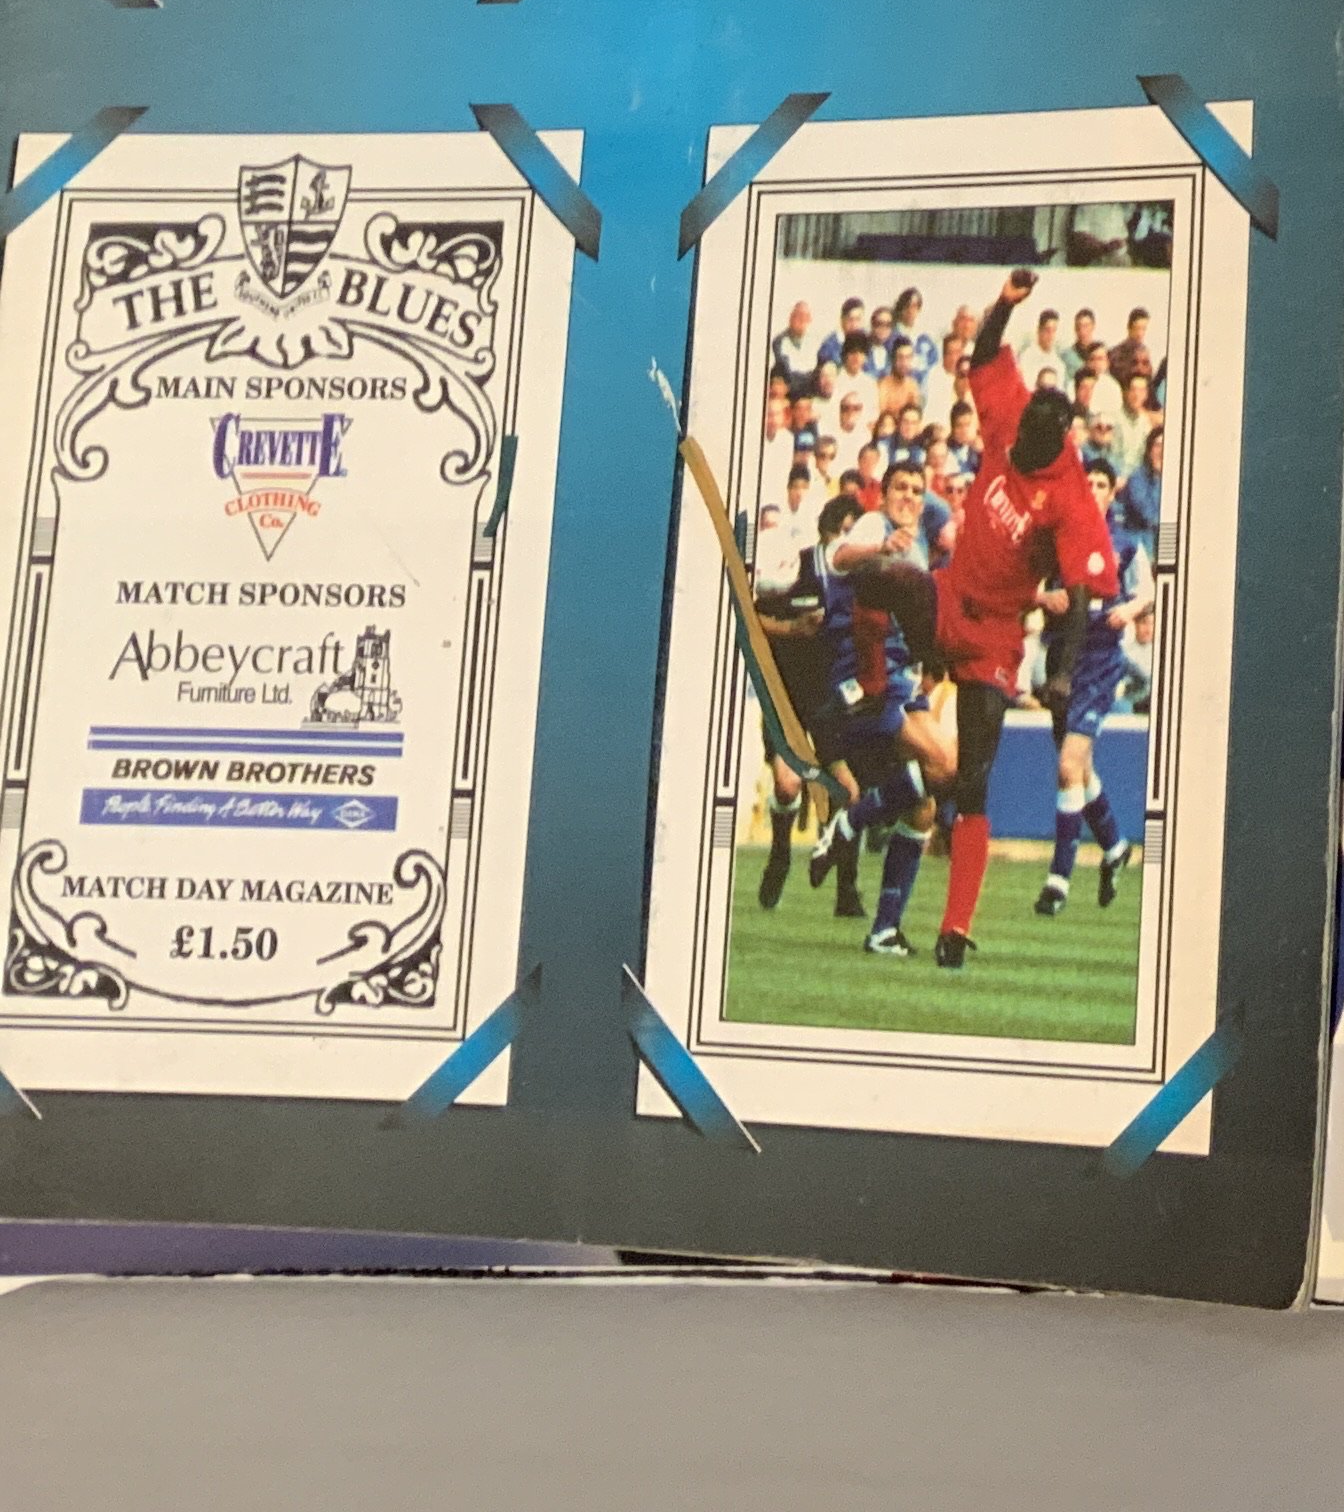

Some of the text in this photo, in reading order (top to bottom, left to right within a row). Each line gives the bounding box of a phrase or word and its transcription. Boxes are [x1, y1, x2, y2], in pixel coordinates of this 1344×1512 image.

[113, 272, 217, 330] THE
[337, 269, 482, 348] BLUES
[157, 377, 406, 400] MAIN SPONSORS
[213, 412, 348, 479] CREVETTE
[223, 492, 323, 517] CLOTHING
[118, 582, 405, 607] MATCH SPONSORS
[109, 630, 345, 684] Abbeycraft
[178, 684, 256, 705] Furniture
[112, 759, 375, 786] BROWN BROTHERS
[62, 876, 393, 904] MATCH DAY MAGAZINE
[171, 926, 278, 960] £1.50
